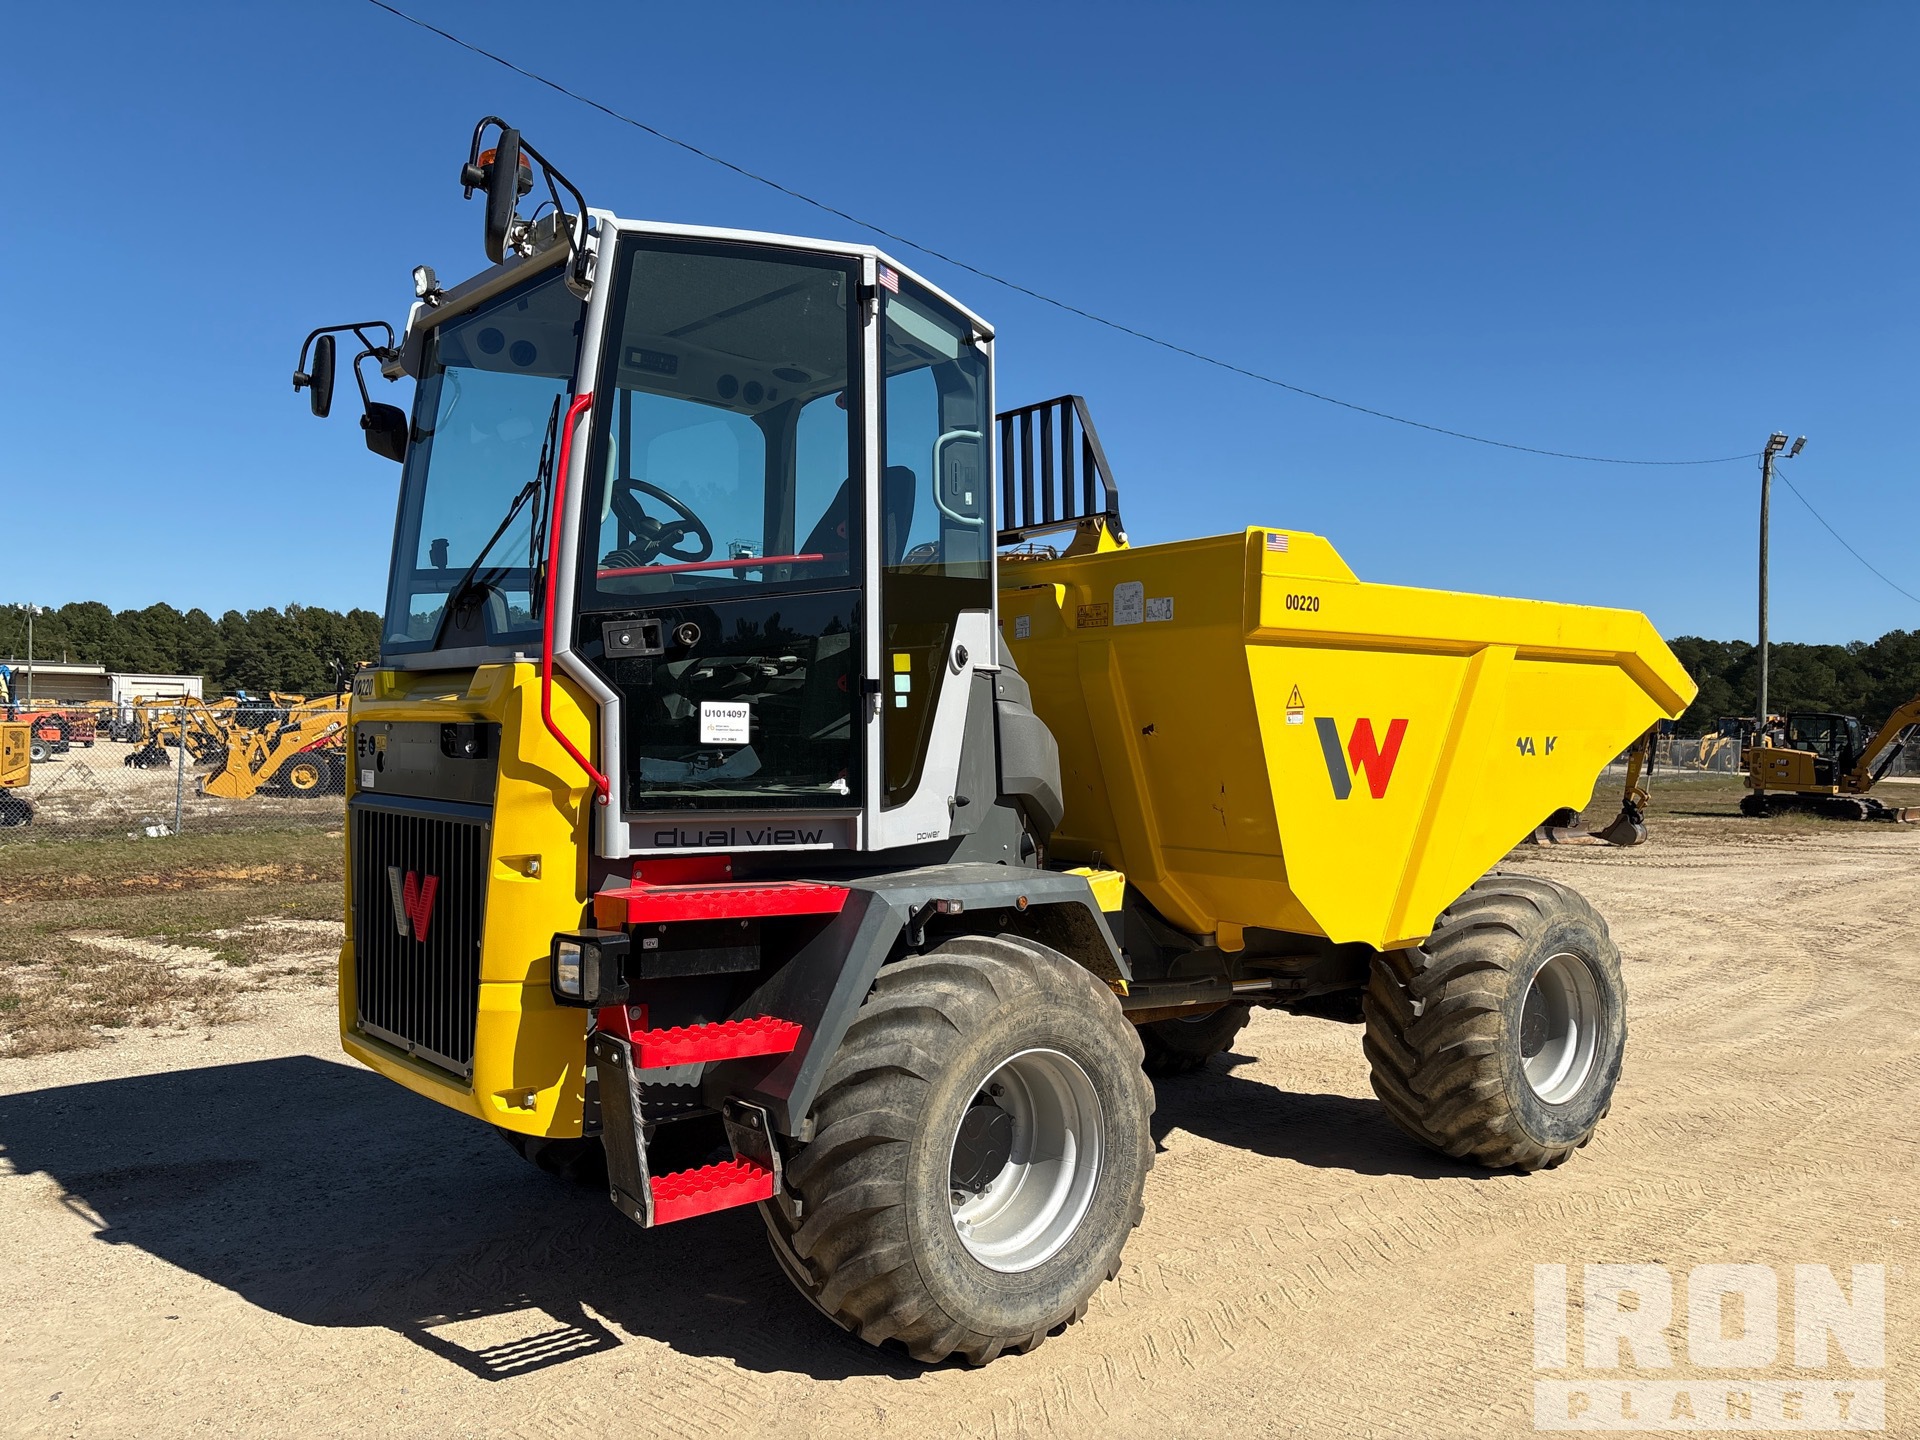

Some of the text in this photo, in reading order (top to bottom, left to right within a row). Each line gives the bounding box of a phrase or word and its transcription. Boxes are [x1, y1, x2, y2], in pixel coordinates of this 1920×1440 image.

[1286, 594, 1320, 612] 00220
[704, 709, 747, 718] U1014097
[1313, 716, 1410, 801] W
[653, 826, 824, 848] dual view
[916, 829, 941, 842] power
